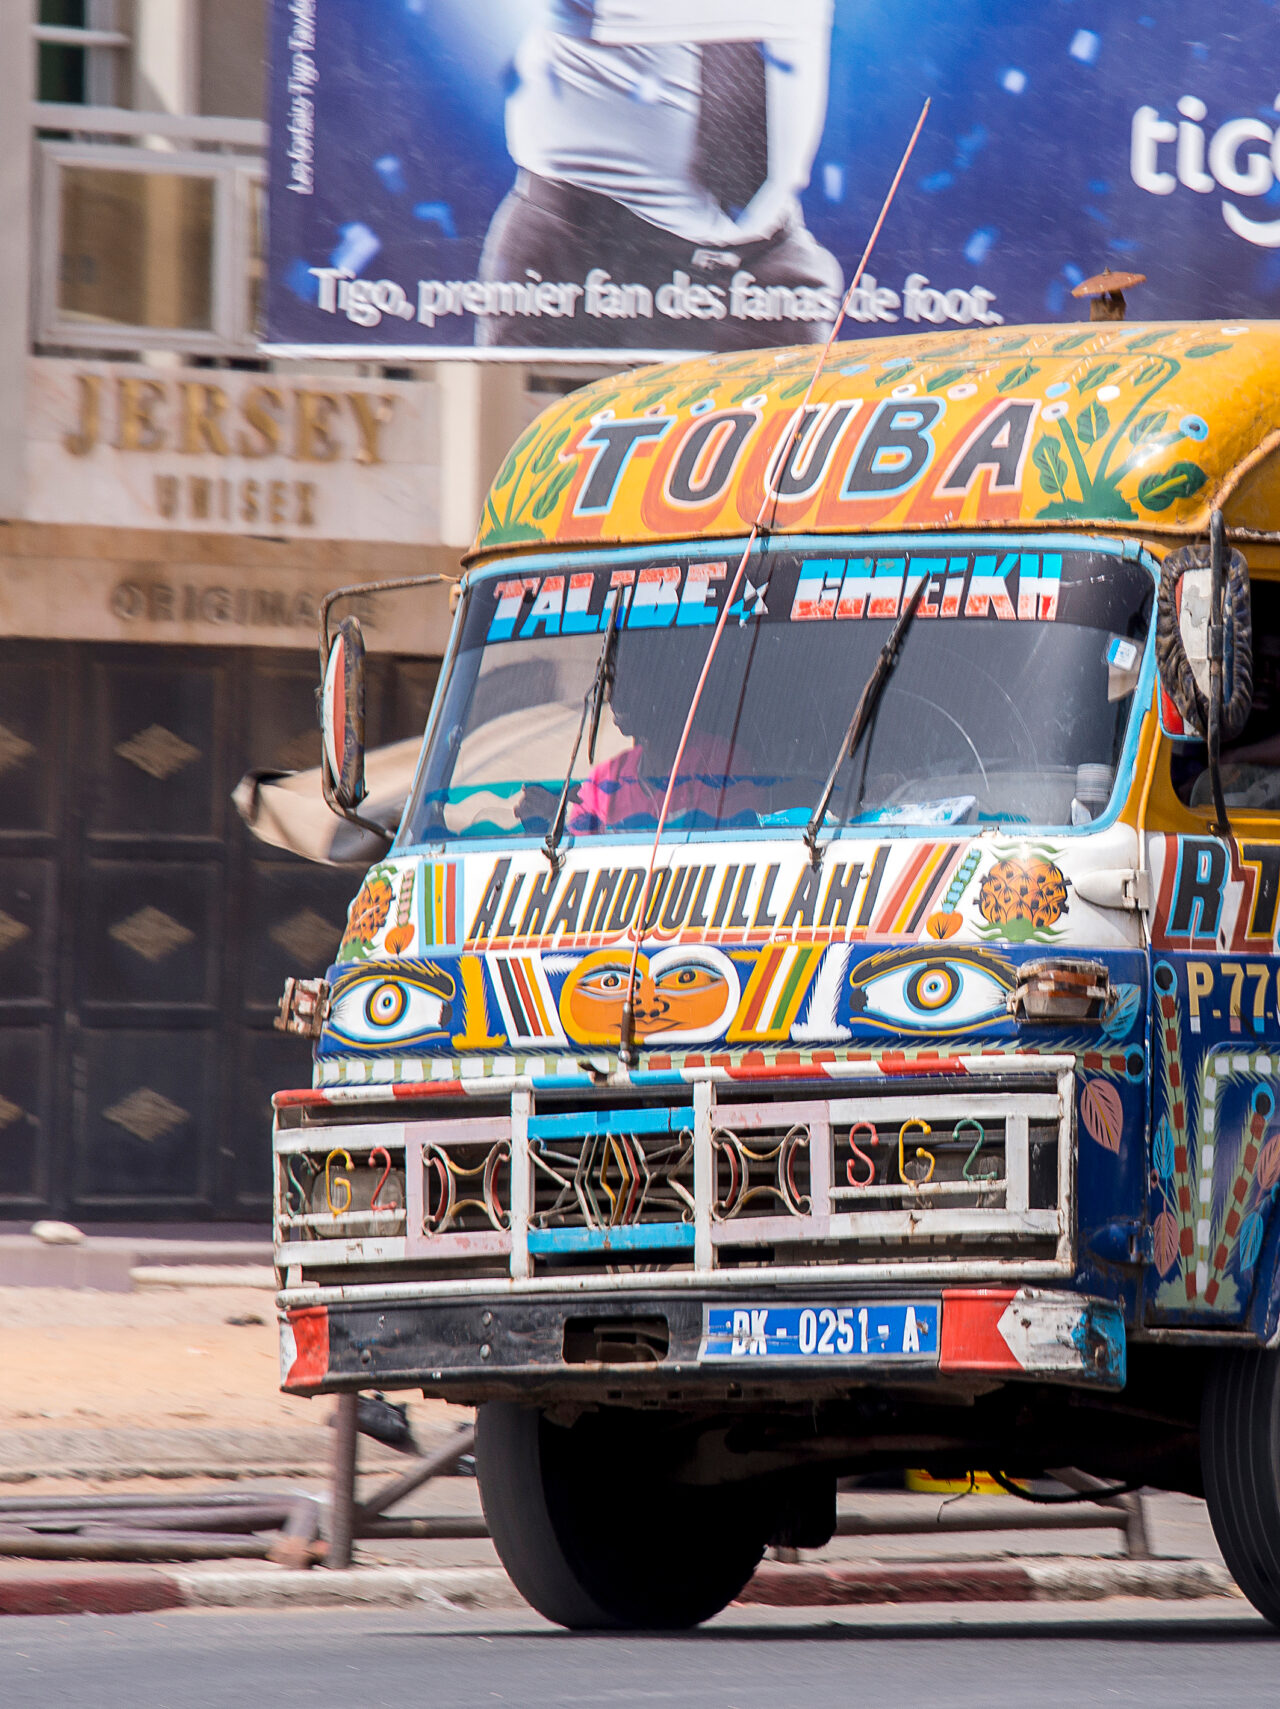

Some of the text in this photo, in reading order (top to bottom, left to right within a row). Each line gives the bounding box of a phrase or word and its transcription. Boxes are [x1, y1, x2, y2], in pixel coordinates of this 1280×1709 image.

[417, 268, 583, 328] premier
[584, 267, 654, 320] fan
[655, 269, 728, 321] des
[843, 272, 901, 323] de
[62, 374, 397, 466] JERSEY
[572, 396, 1042, 518] TOUBA
[153, 473, 317, 525] UNISEX
[486, 561, 728, 643] TALIBE
[731, 1309, 769, 1355] DK
[799, 1307, 869, 1354] 0251
[902, 1306, 921, 1352] A
